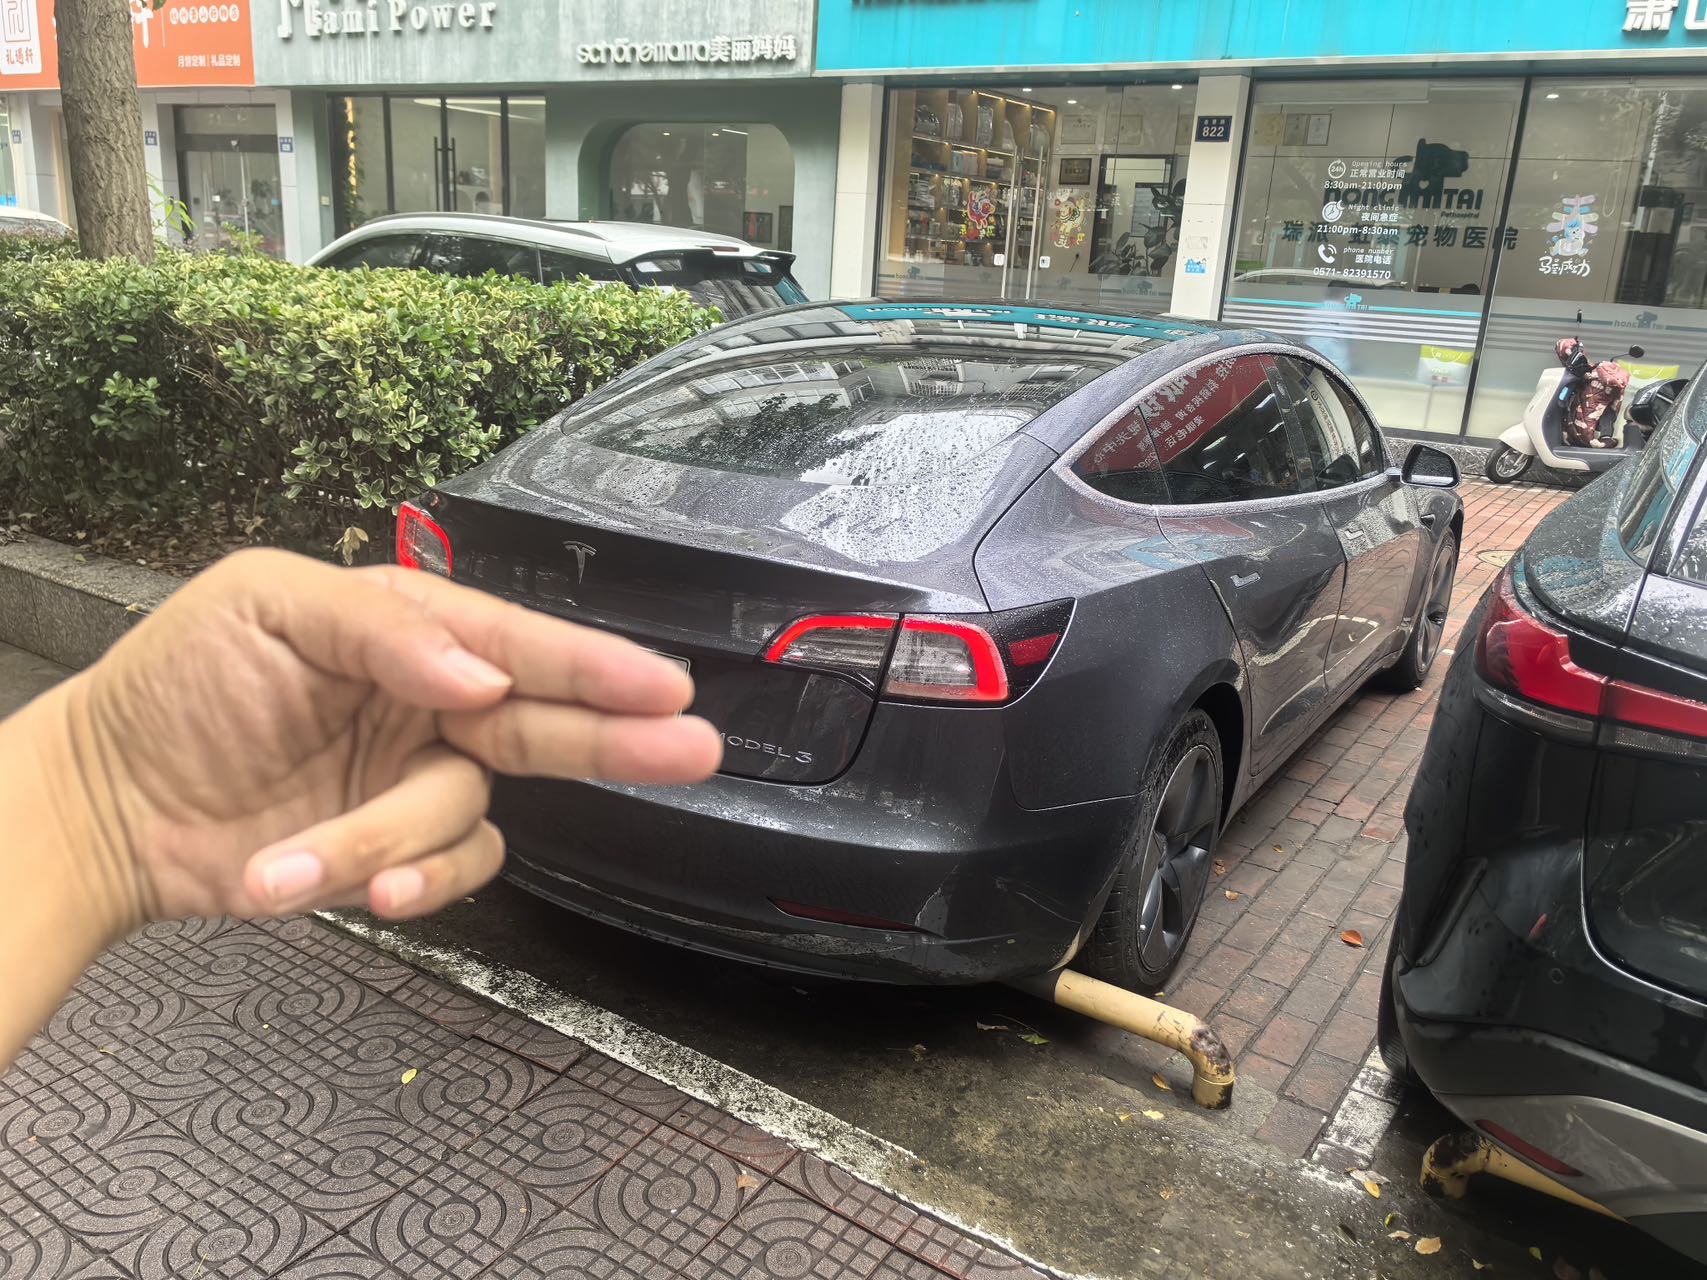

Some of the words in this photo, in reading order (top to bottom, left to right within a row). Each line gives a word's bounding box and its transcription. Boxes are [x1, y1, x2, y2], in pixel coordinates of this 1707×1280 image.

[389, 0, 497, 31] Power
[1202, 126, 1224, 137] 822
[1350, 169, 1405, 178] 正常营业时间
[1324, 180, 1403, 191] 8:30am-21:00pm
[1361, 212, 1398, 222] 夜间急症
[1317, 224, 1398, 235] 21:00pm-8:30am
[1355, 254, 1391, 264] 医院电话
[1313, 267, 1391, 280] 0571-82391570
[795, 751, 813, 764] 3
